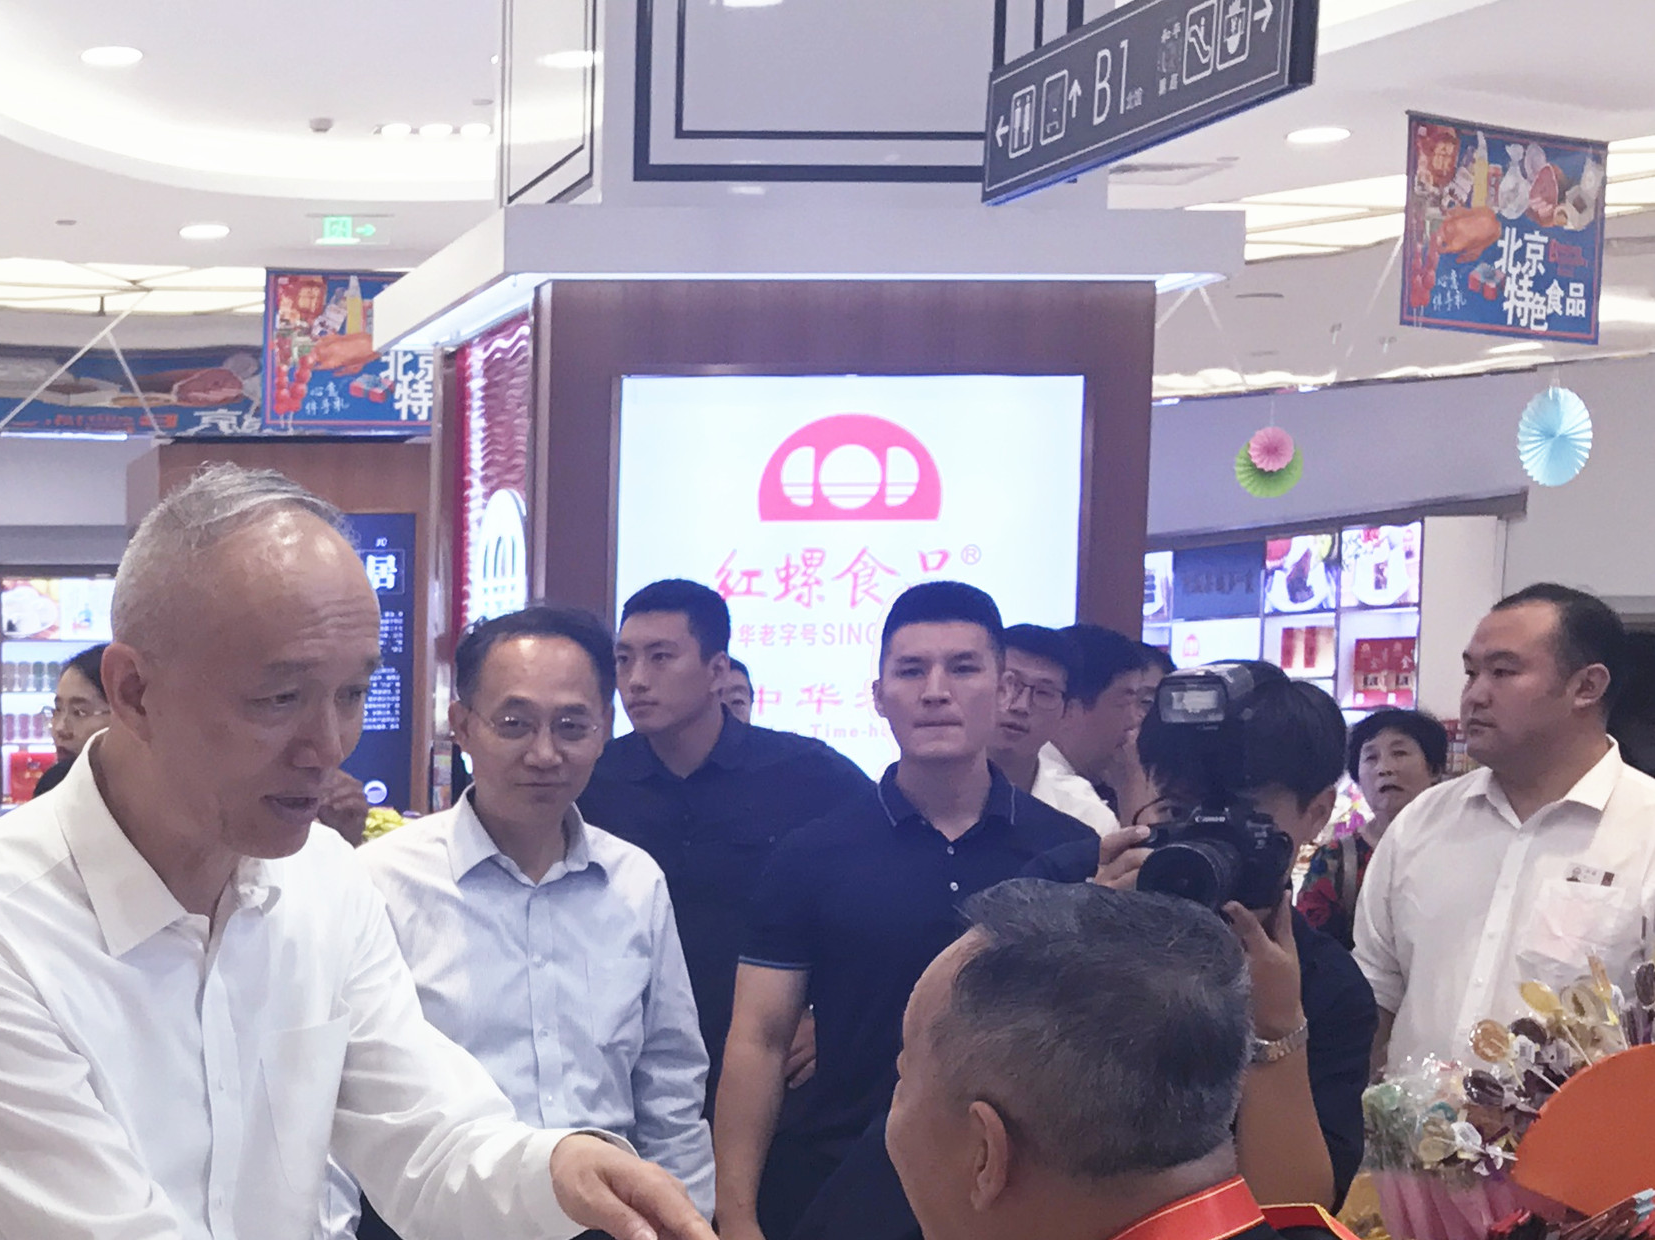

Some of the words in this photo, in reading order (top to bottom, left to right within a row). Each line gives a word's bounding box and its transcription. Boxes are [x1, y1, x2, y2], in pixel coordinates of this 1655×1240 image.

[1092, 38, 1129, 126] B1
[1494, 226, 1549, 277] 北京
[1502, 271, 1587, 332] 特色食品
[811, 724, 888, 739] Time-h
